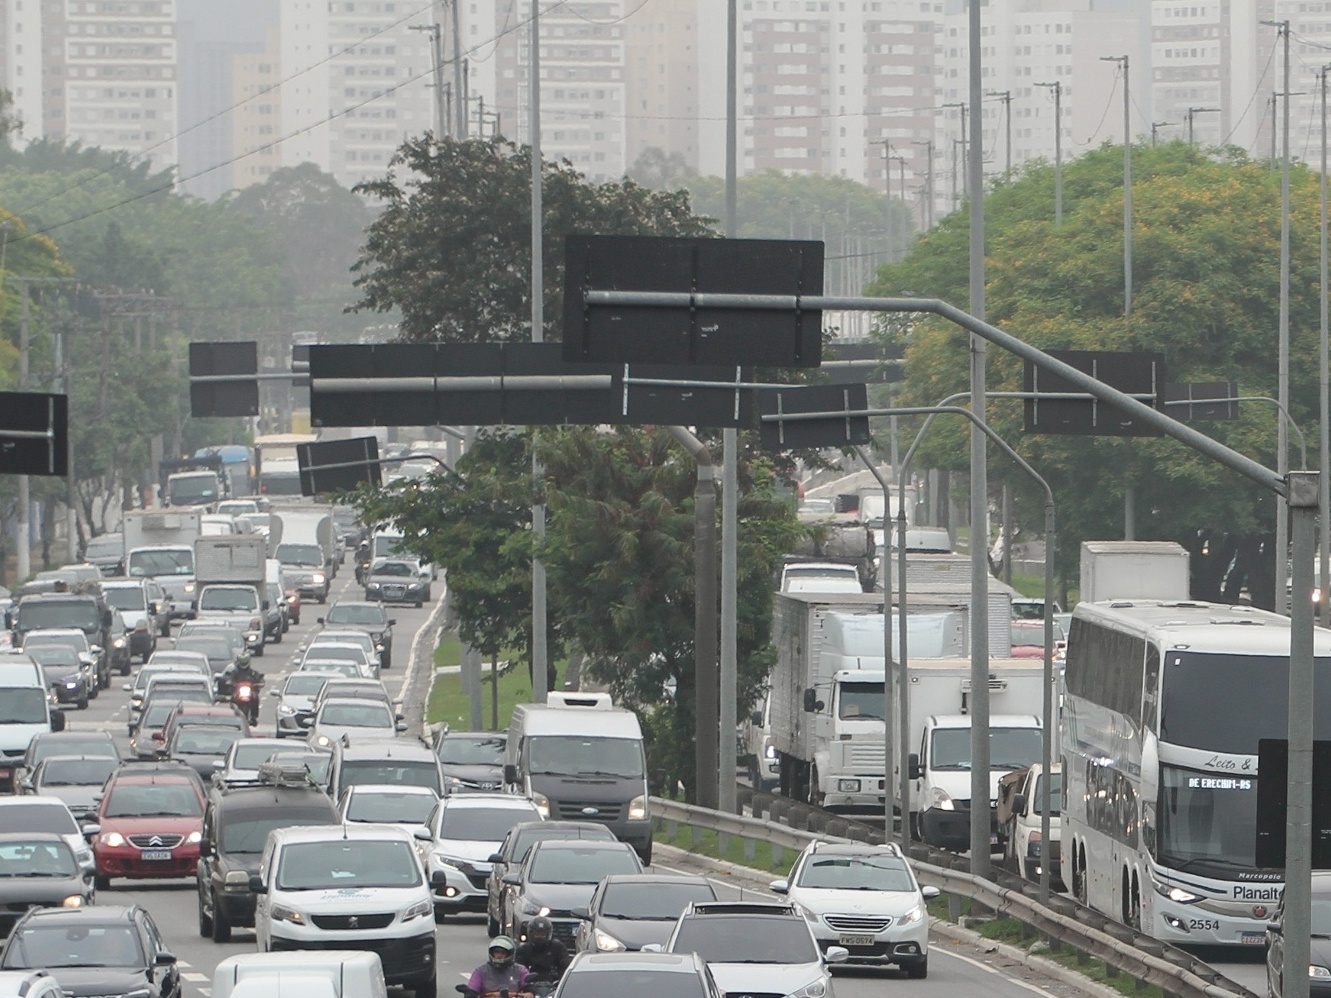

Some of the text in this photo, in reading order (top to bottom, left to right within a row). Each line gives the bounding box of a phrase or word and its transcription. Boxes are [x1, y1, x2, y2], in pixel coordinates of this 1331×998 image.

[1204, 755, 1251, 770] Leito &
[1188, 778, 1251, 790] DE ERECHIM-RS
[1238, 872, 1282, 880] Marcopolo
[1189, 919, 1220, 931] 2554
